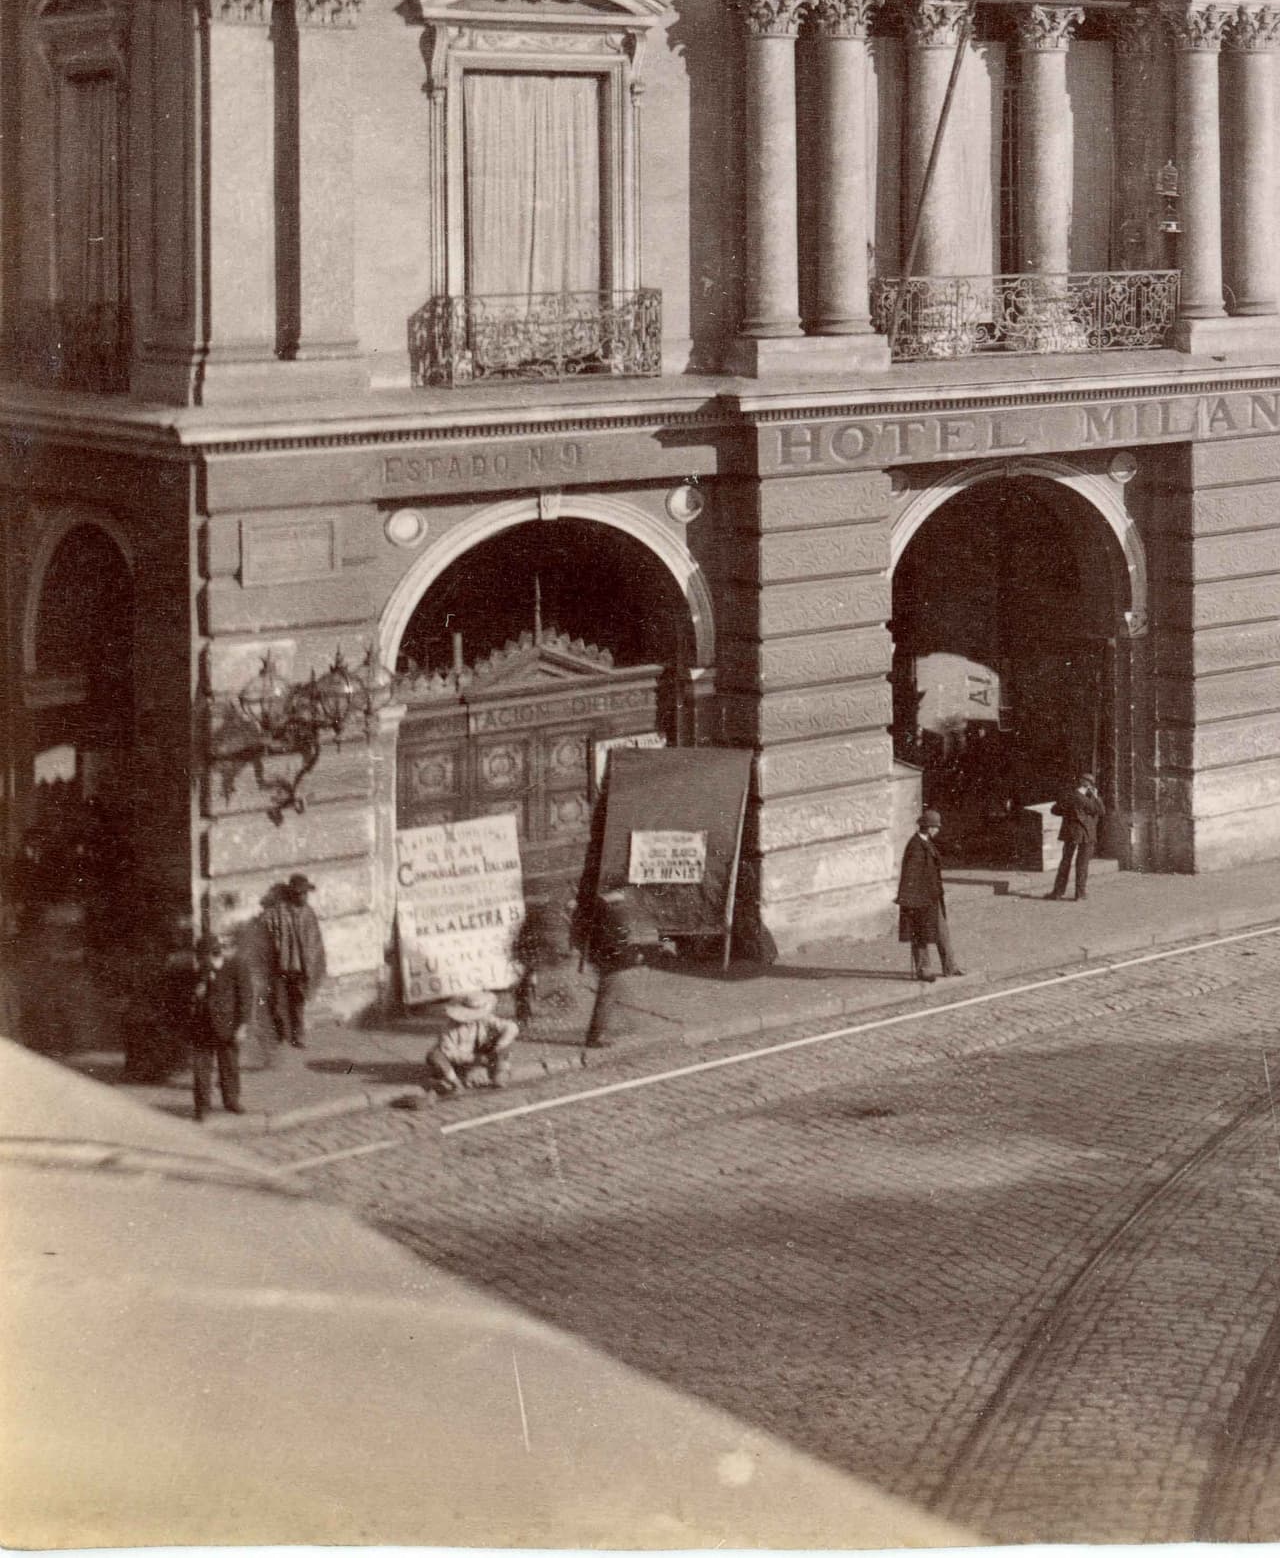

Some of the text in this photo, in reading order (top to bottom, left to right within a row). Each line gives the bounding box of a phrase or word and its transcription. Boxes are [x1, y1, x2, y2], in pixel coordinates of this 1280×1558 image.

[775, 411, 1028, 468] HOTEL
[383, 451, 510, 484] ESTADO
[458, 908, 504, 930] LETRA
